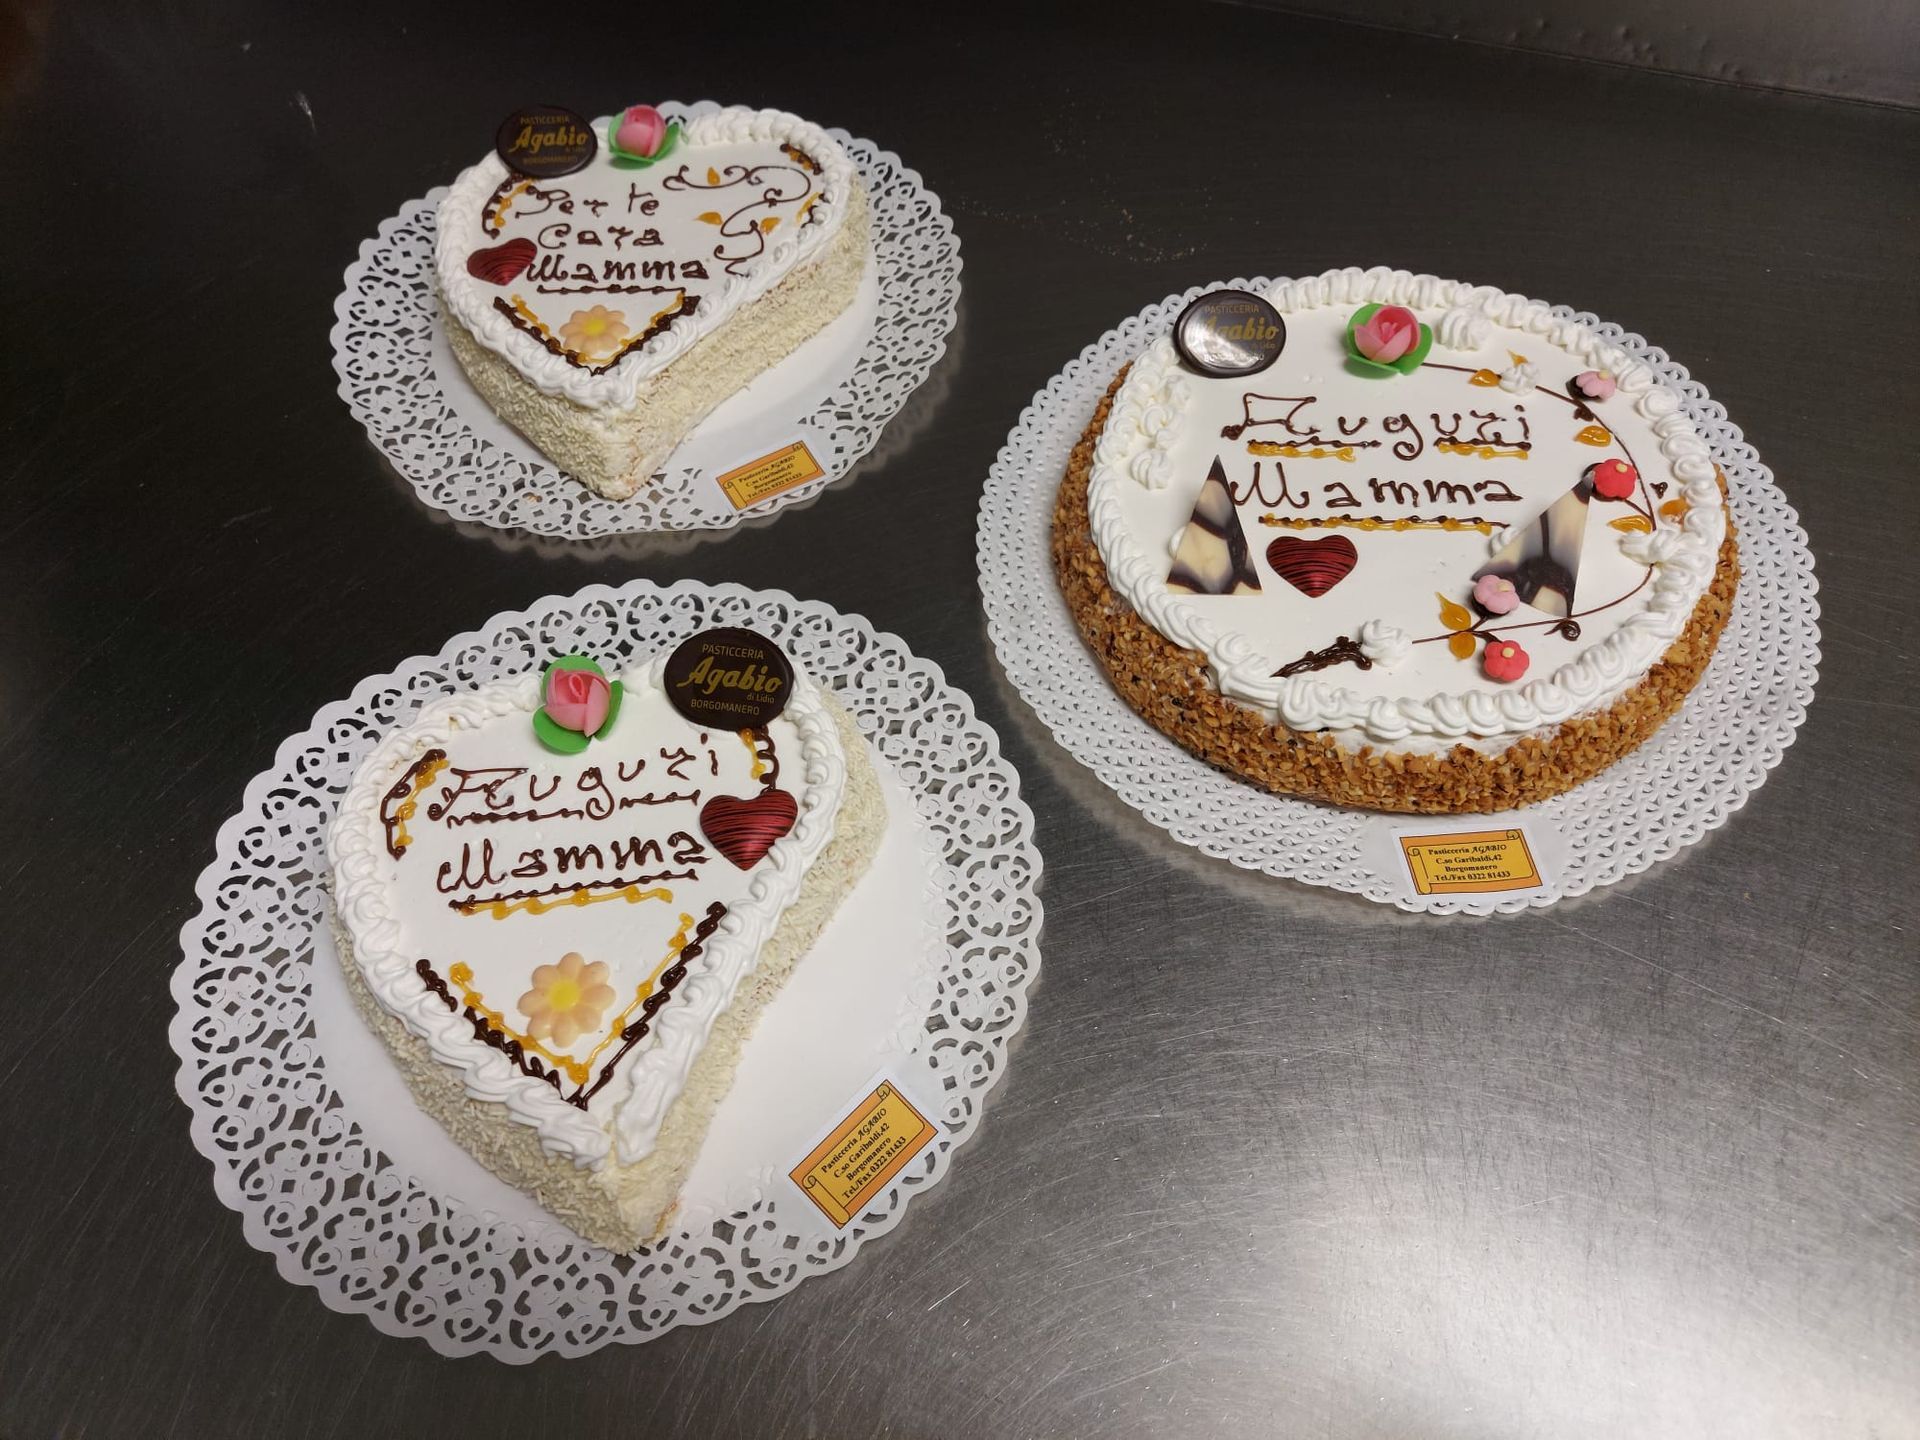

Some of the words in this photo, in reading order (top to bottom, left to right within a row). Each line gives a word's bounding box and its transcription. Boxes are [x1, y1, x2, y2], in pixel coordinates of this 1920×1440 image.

[507, 126, 588, 154] Agabio
[515, 184, 608, 219] Per
[627, 182, 660, 216] te
[538, 223, 664, 251] Cara
[526, 254, 709, 283] Mamma
[1204, 304, 1260, 314] PASTICCERIA
[1221, 392, 1532, 461] Auguri
[1229, 462, 1523, 509] Mamma
[702, 643, 765, 660] PASTICCERIA
[676, 655, 783, 695] Agabio
[690, 698, 760, 716] BORGOMANERO
[756, 694, 775, 704] Lidio
[427, 734, 721, 820] Auguri
[436, 831, 711, 893] Mamma
[1428, 847, 1470, 856] Pasticceria
[1471, 844, 1507, 854] AGABIO
[1445, 864, 1498, 873] Borgomanero
[1467, 872, 1487, 880] 0322
[1487, 870, 1511, 879] 81433
[820, 1137, 858, 1174] Pasticceria
[858, 1108, 888, 1141] AGABIO
[870, 1155, 888, 1173] 0322
[886, 1136, 907, 1157] 81433
[833, 1162, 850, 1178] C.so
[846, 1137, 891, 1182] Borgomanero
